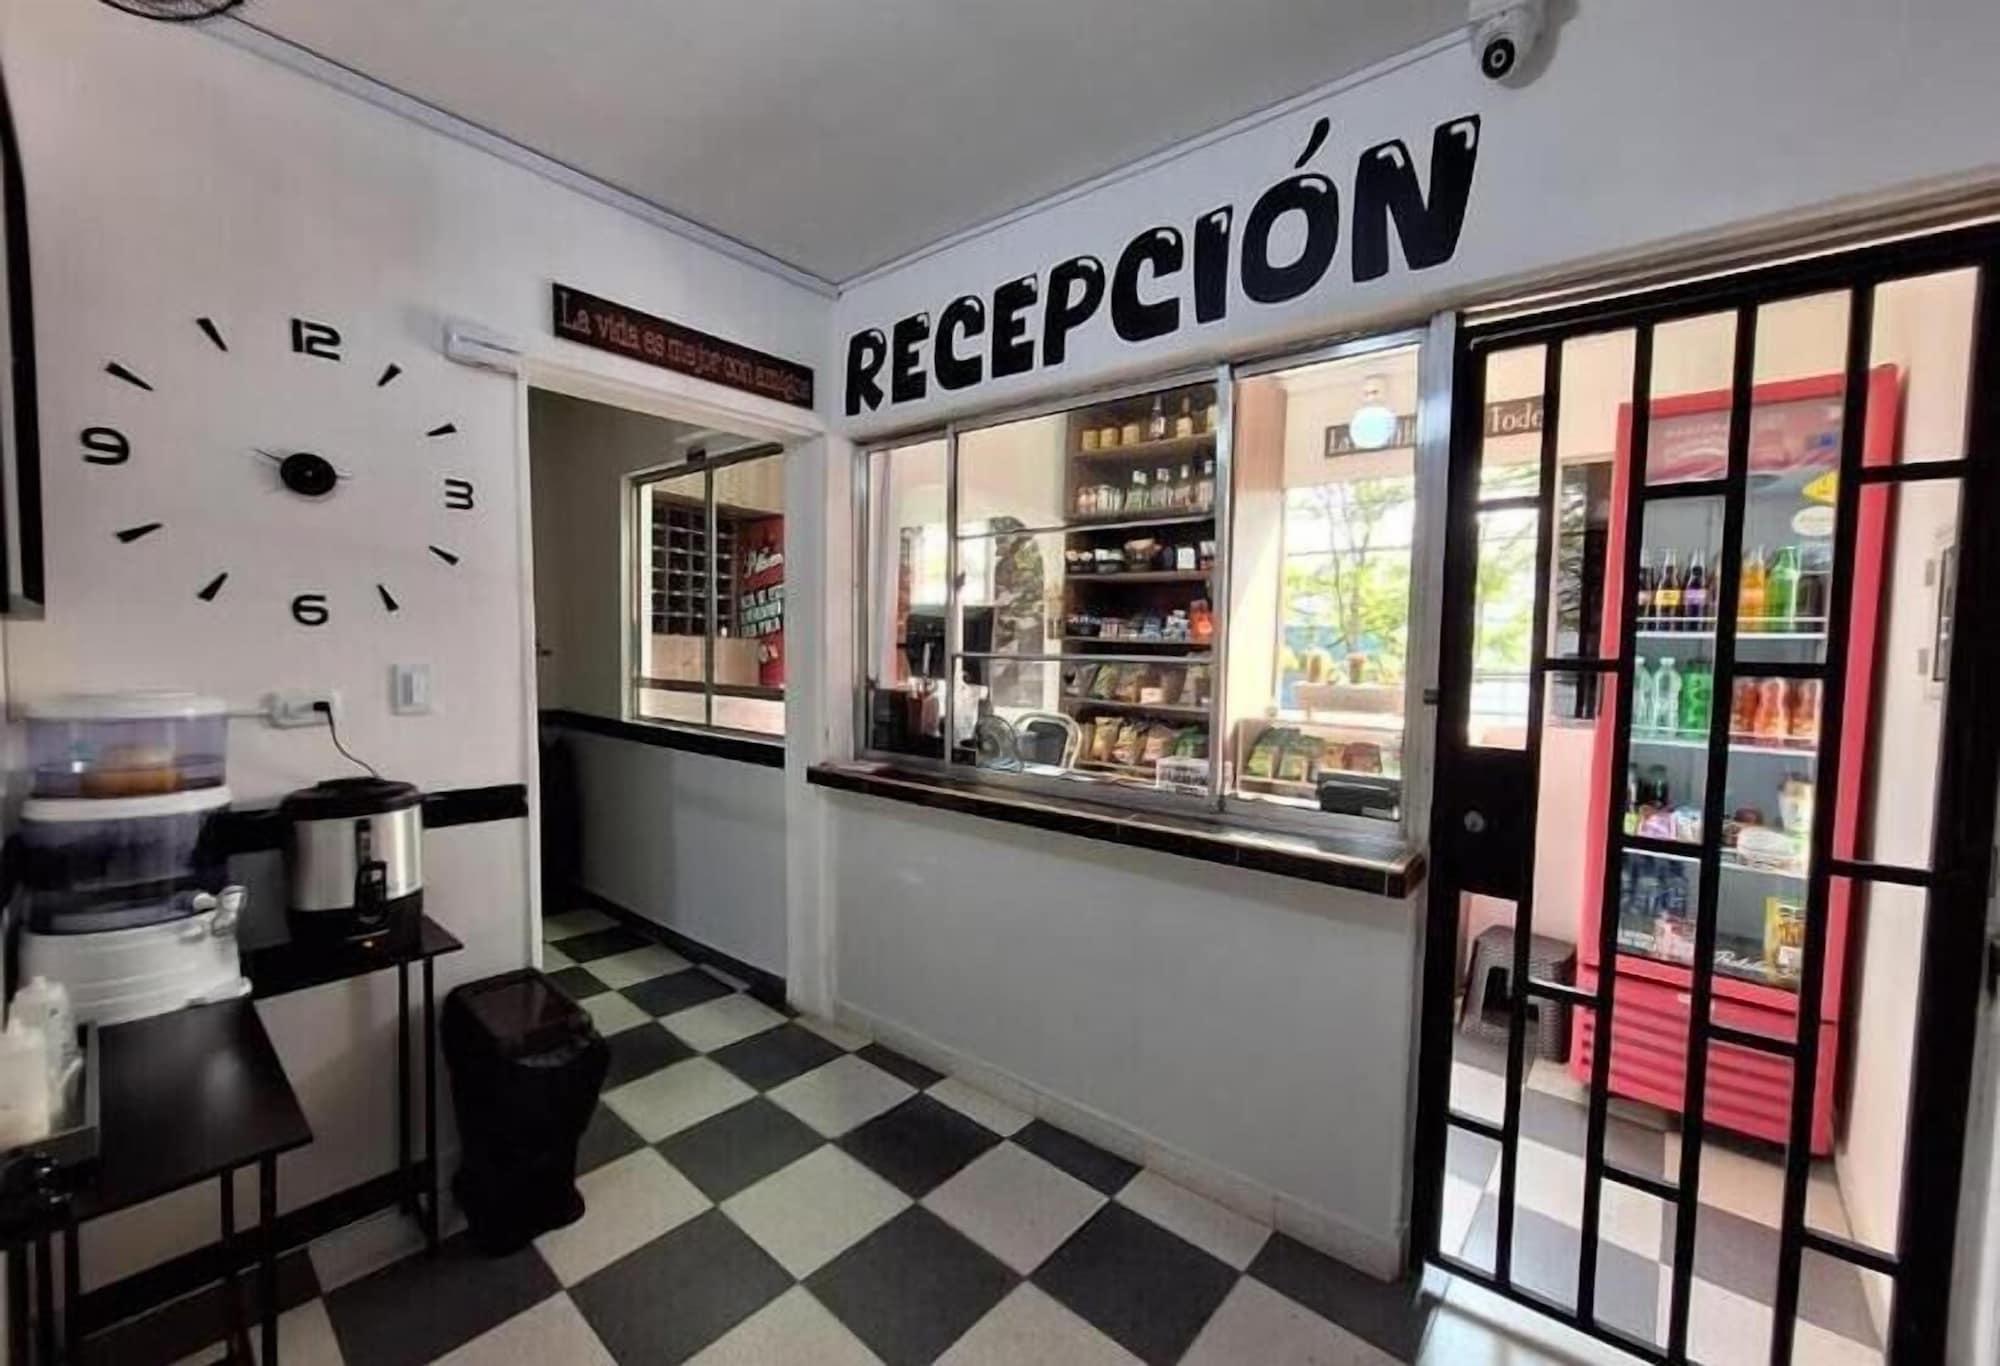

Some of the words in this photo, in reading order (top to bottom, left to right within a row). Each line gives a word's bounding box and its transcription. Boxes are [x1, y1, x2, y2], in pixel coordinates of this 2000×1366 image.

[846, 115, 1481, 416] RECEPCIÓN
[291, 317, 341, 361] 12
[561, 291, 592, 335] La
[594, 312, 640, 350] vida
[642, 330, 666, 357] es
[80, 426, 131, 466] 9
[445, 478, 474, 510] 3
[291, 594, 329, 627] 6
